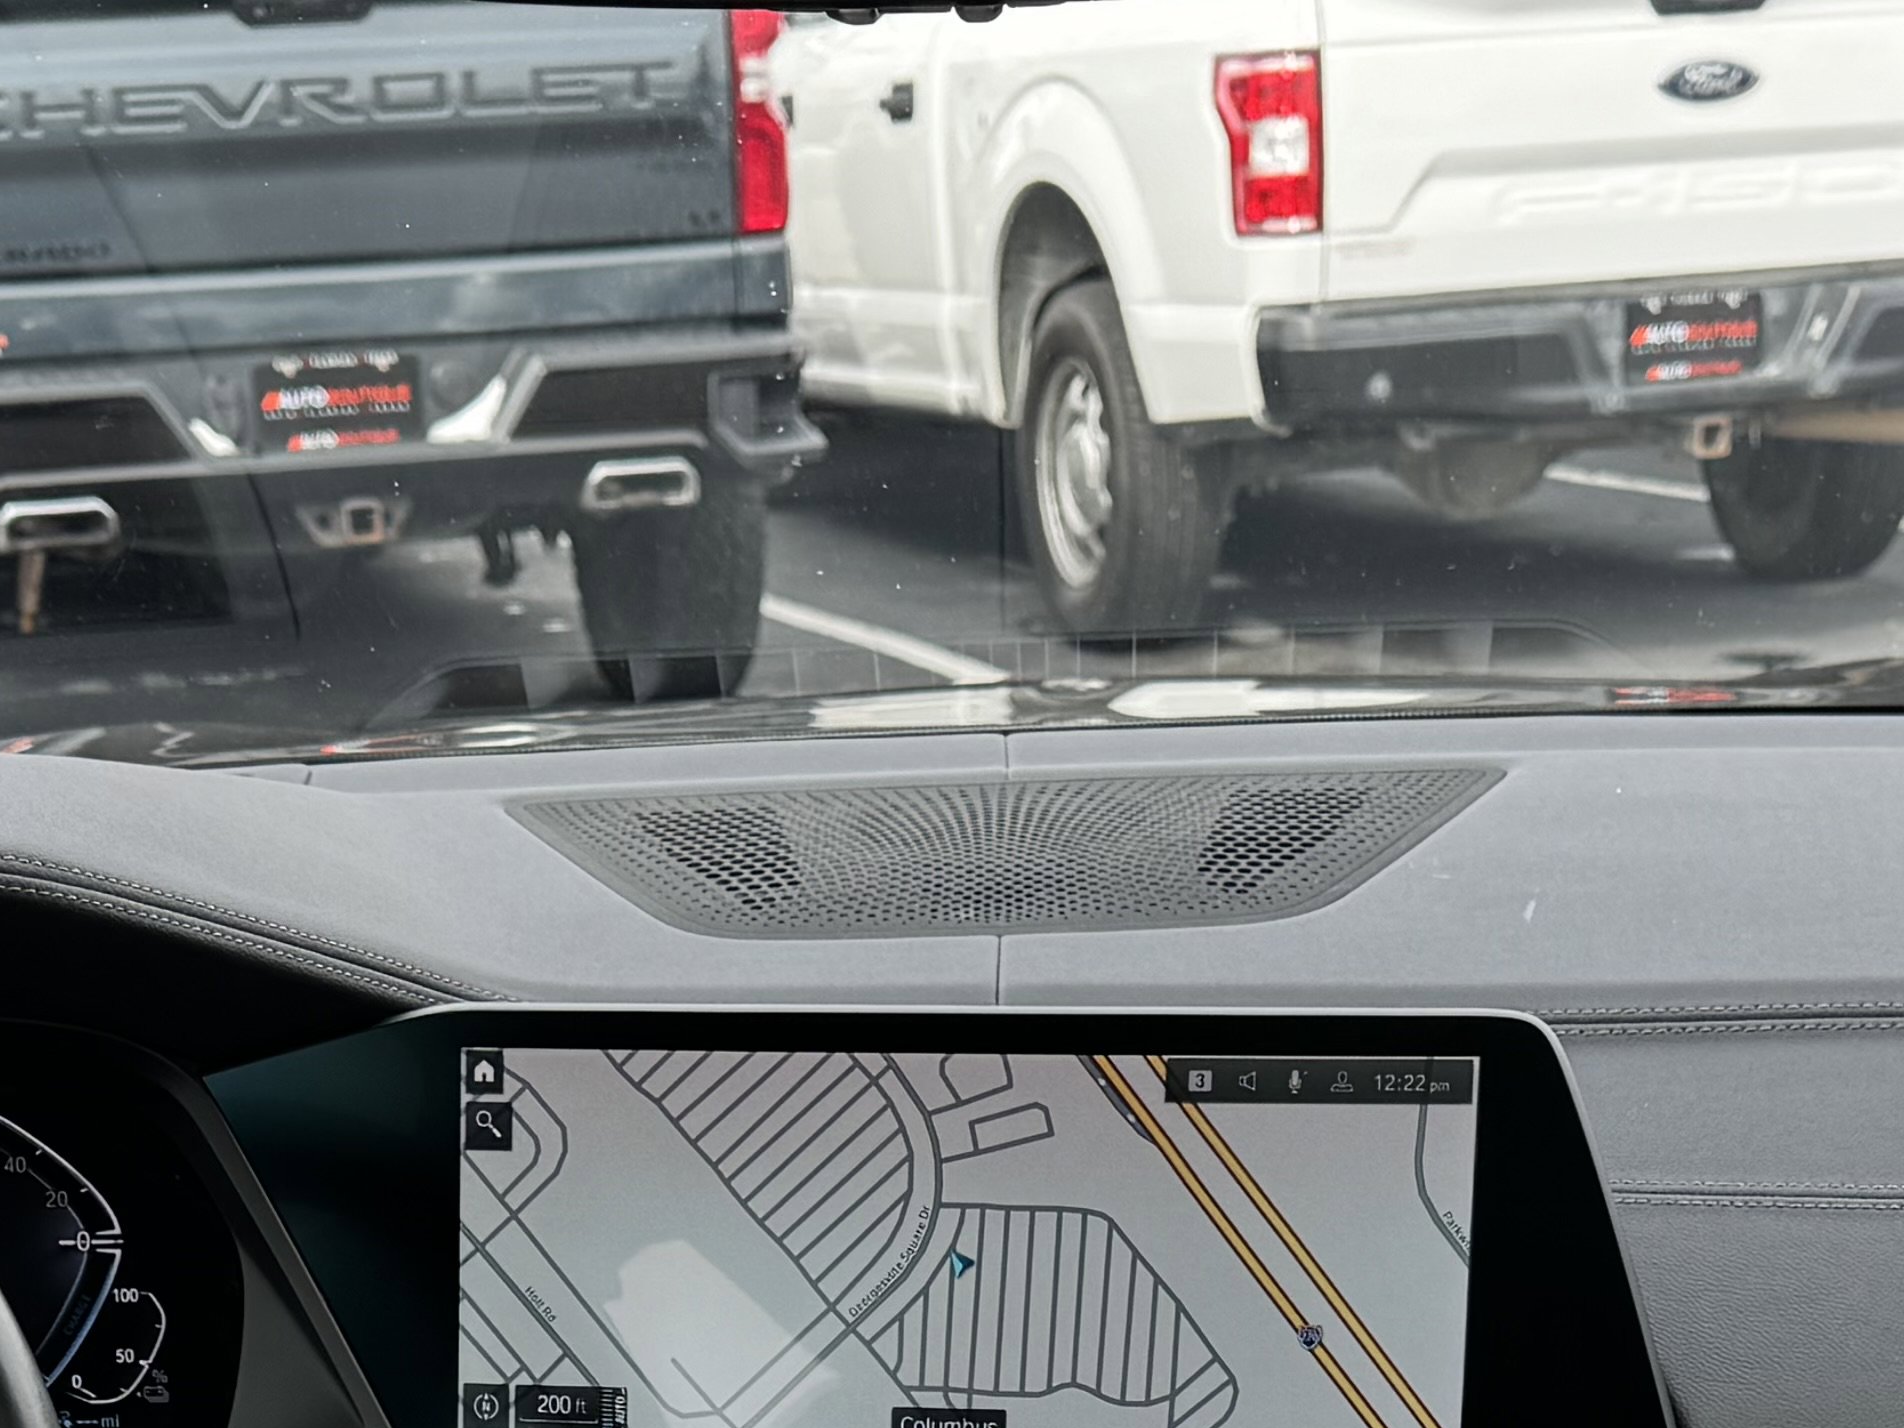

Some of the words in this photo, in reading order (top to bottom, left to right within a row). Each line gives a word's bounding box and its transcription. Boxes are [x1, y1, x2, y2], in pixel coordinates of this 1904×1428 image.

[1374, 1073, 1426, 1092] 12:22
[1429, 1080, 1450, 1093] pm
[3, 1156, 27, 1175] 40
[45, 1190, 69, 1209] 20
[76, 1230, 92, 1252] 0
[112, 1287, 139, 1303] 100
[114, 1348, 135, 1364] 50
[71, 1374, 83, 1389] 0
[536, 1394, 572, 1415] 200
[575, 1397, 588, 1414] ft
[100, 1413, 121, 1428] mi
